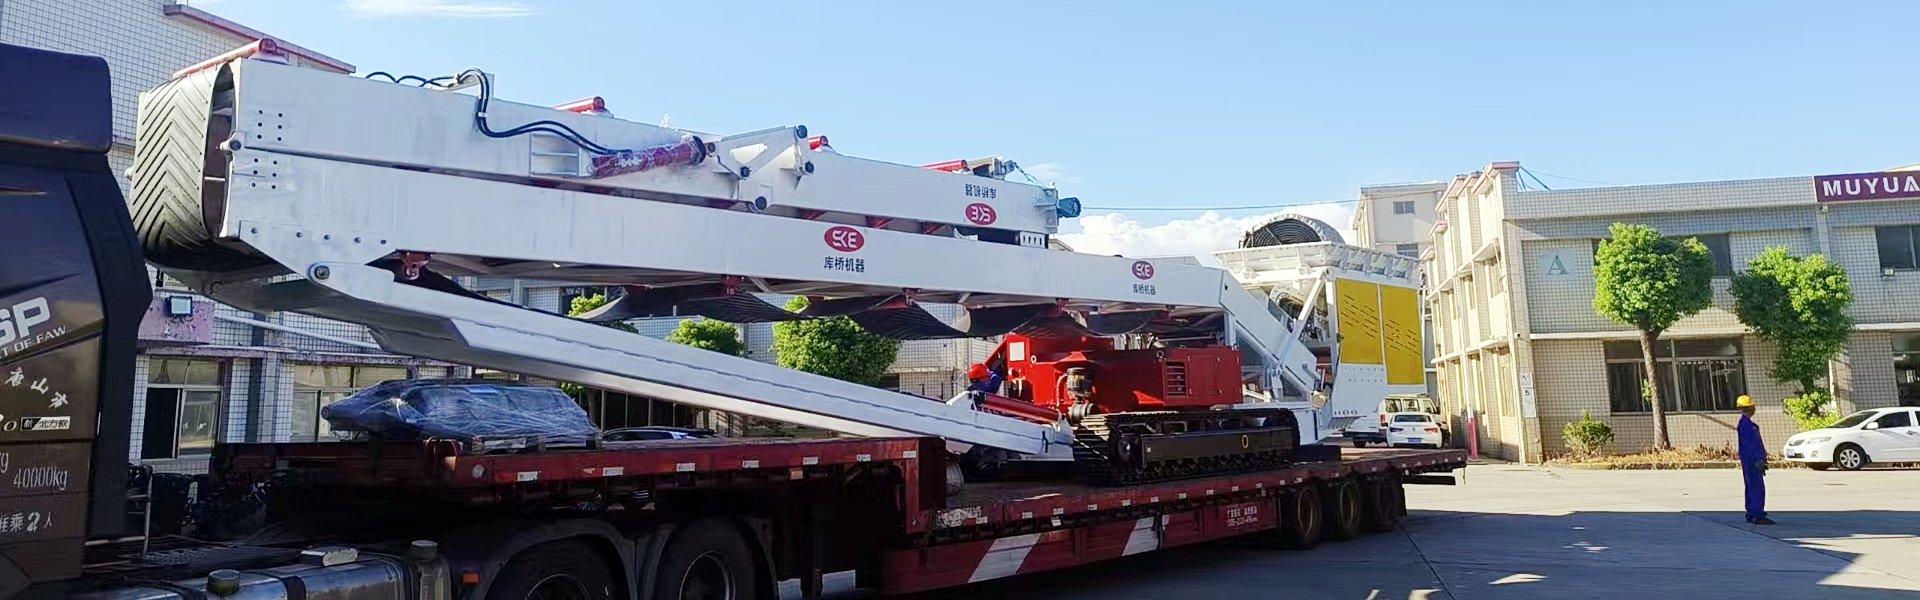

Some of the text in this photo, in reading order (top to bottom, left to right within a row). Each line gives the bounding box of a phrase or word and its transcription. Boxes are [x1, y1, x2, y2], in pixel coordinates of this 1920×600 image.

[1822, 175, 1920, 197] MUYUA
[832, 230, 858, 248] SKE
[824, 256, 865, 273] 库桥机器
[1135, 263, 1151, 277] SKE
[1547, 253, 1569, 275] A
[14, 338, 34, 352] OF
[36, 325, 67, 344] FAW
[13, 465, 67, 491] 40000kg
